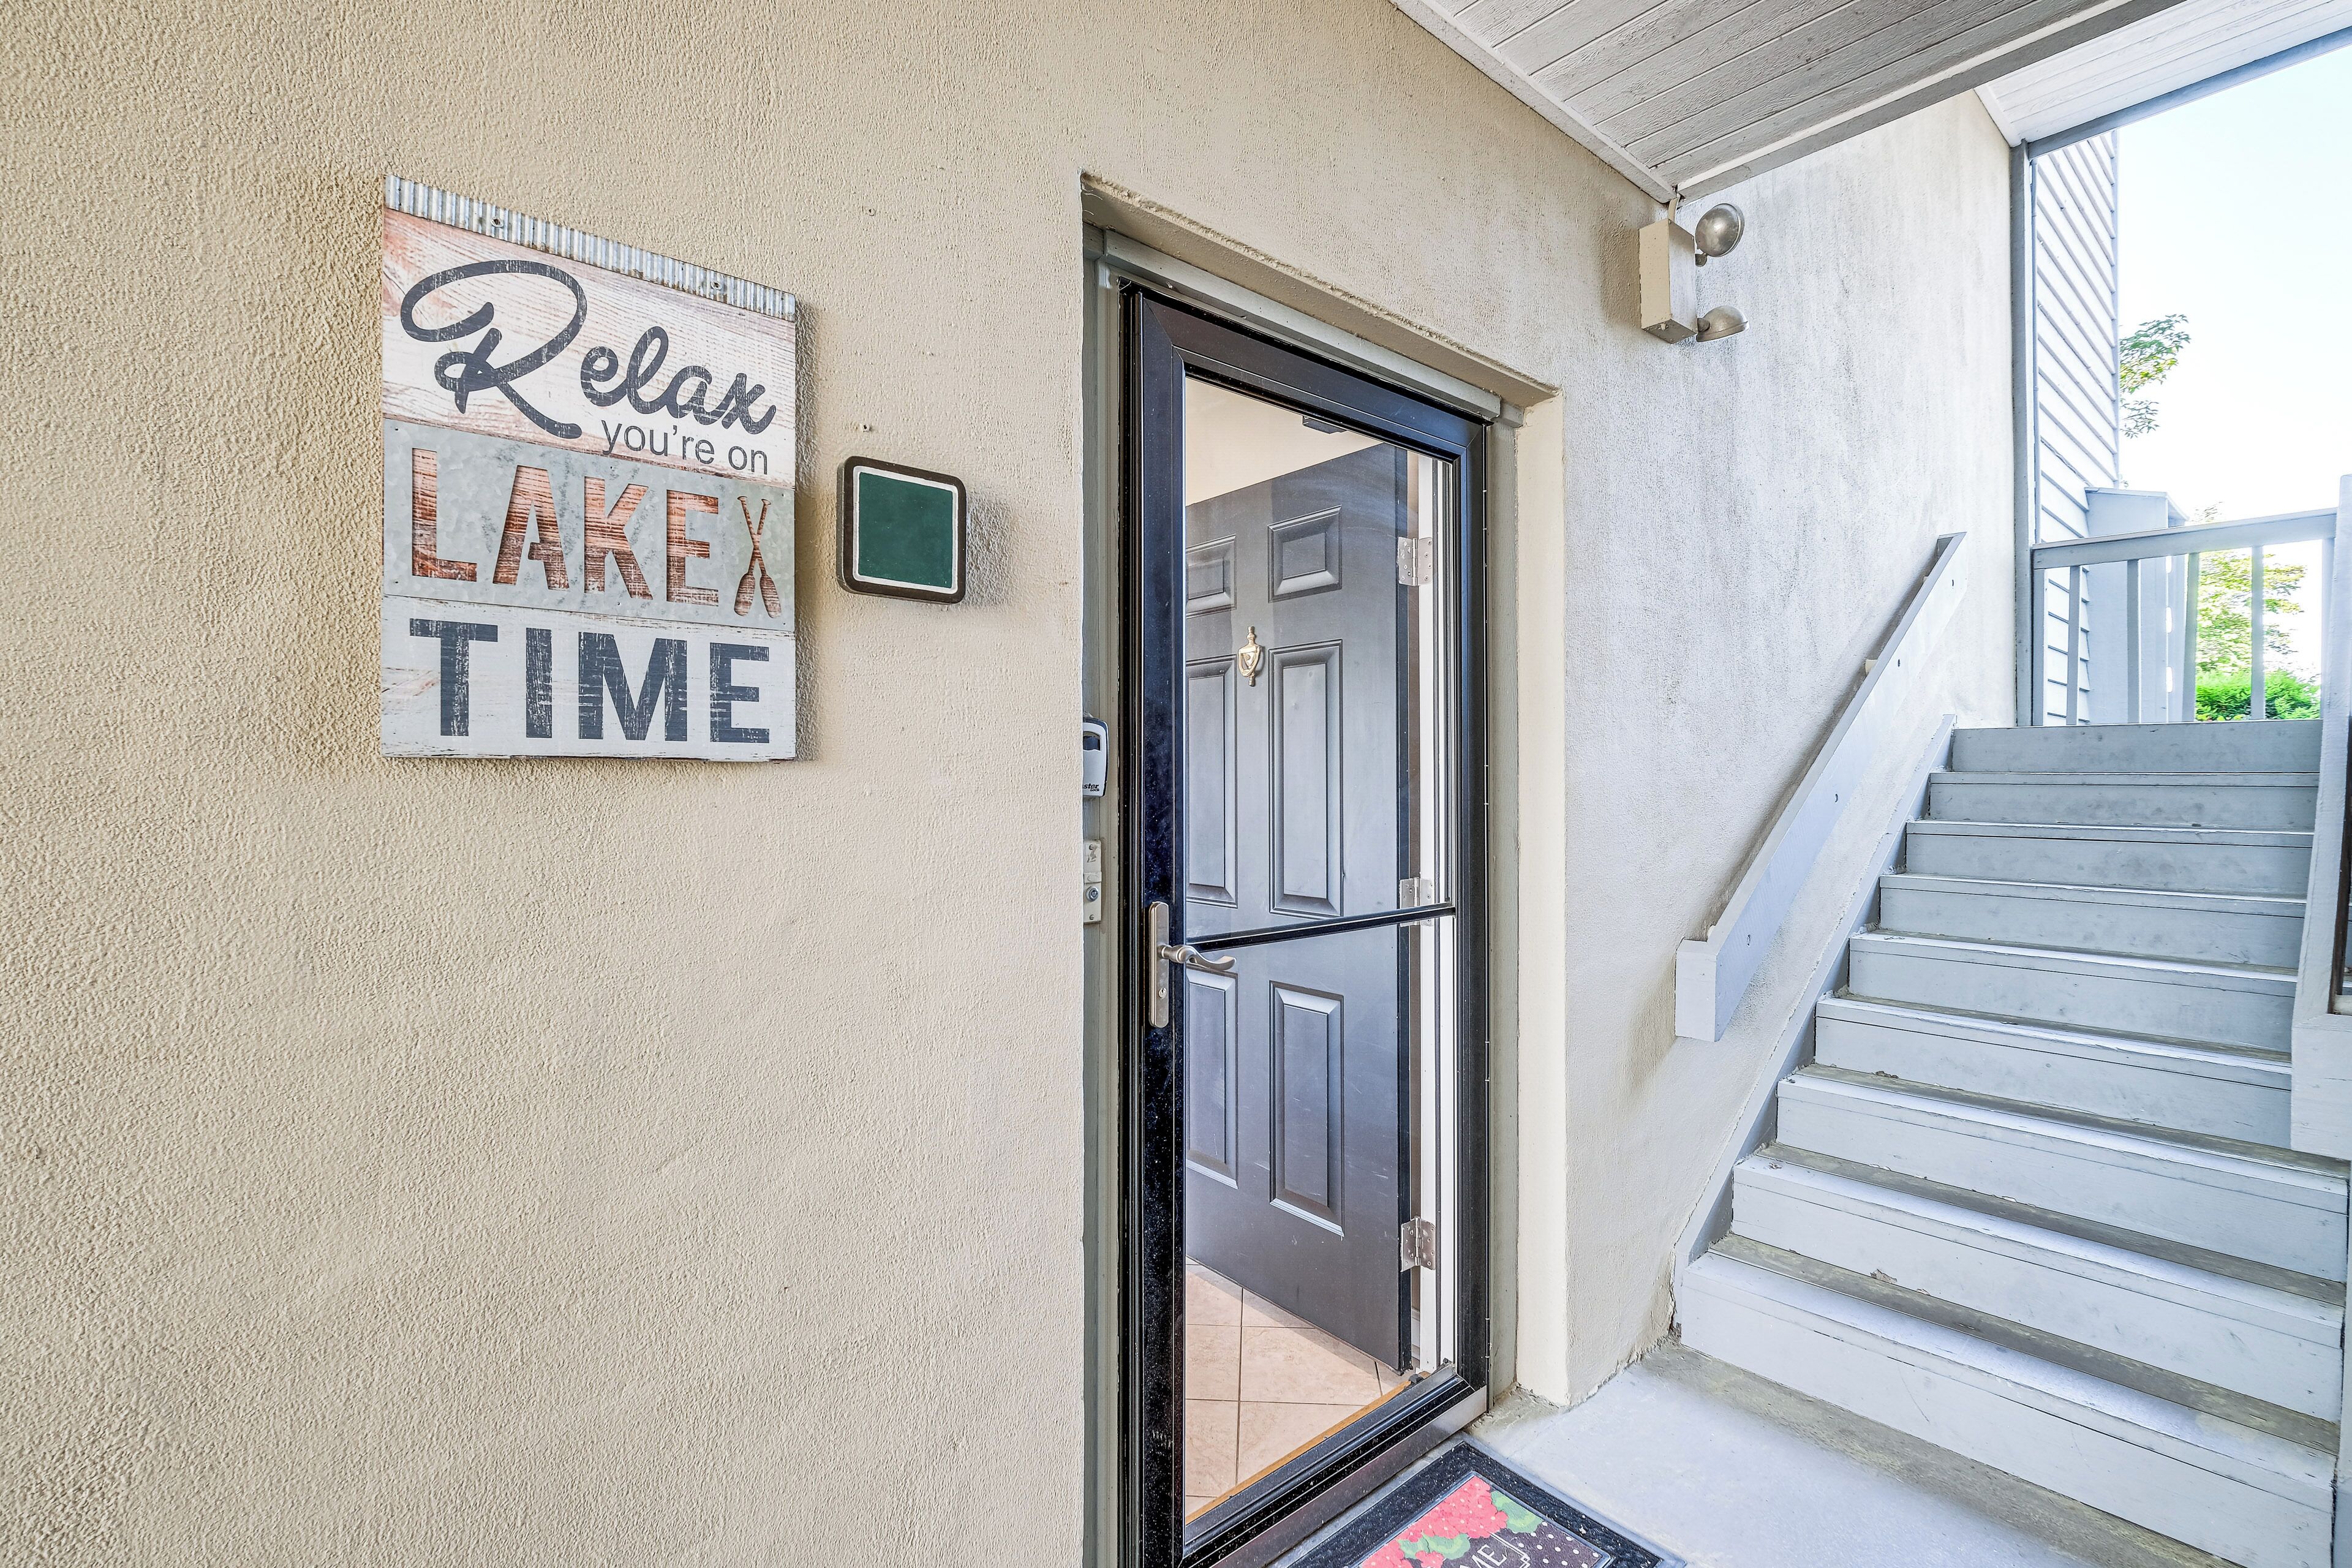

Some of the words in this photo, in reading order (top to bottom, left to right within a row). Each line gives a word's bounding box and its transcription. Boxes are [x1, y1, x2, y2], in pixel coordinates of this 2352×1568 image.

[400, 260, 777, 439] Relax
[601, 420, 715, 464] you're
[728, 446, 767, 475] on
[412, 448, 719, 606] LAKE
[410, 618, 770, 744] TIME
